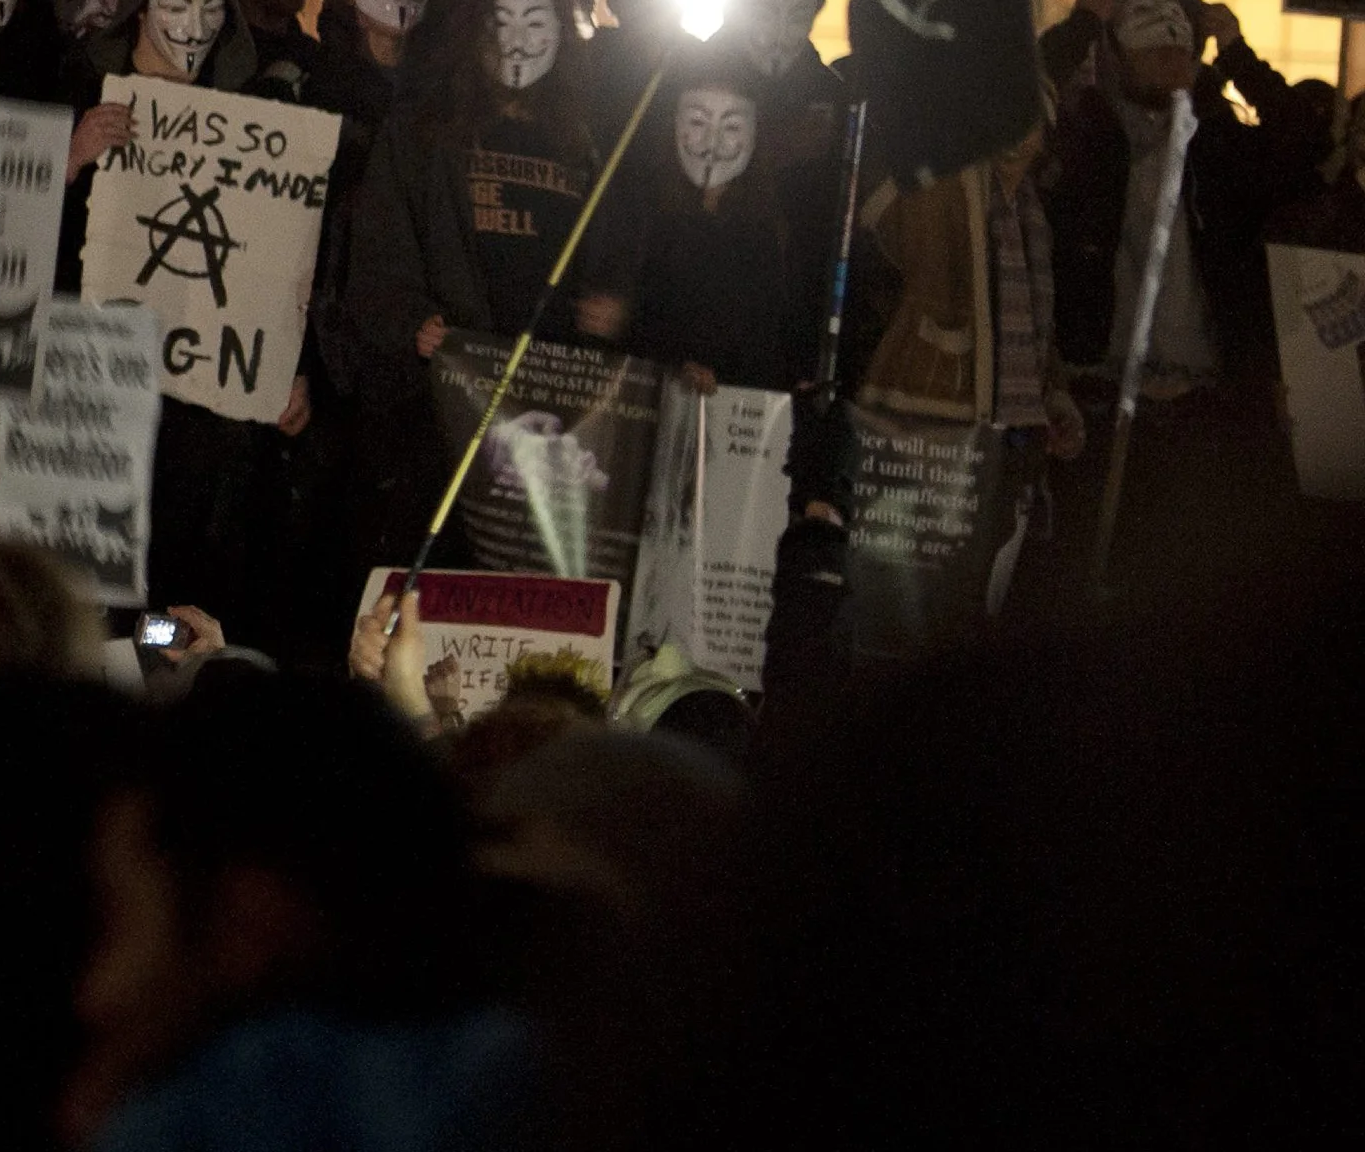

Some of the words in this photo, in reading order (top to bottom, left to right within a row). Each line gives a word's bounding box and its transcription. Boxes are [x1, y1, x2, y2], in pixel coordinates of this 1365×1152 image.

[150, 99, 229, 147] WAS
[235, 123, 289, 159] SO
[105, 140, 207, 181] ANGRY
[214, 161, 242, 189] I
[527, 340, 605, 365] UNBLANE
